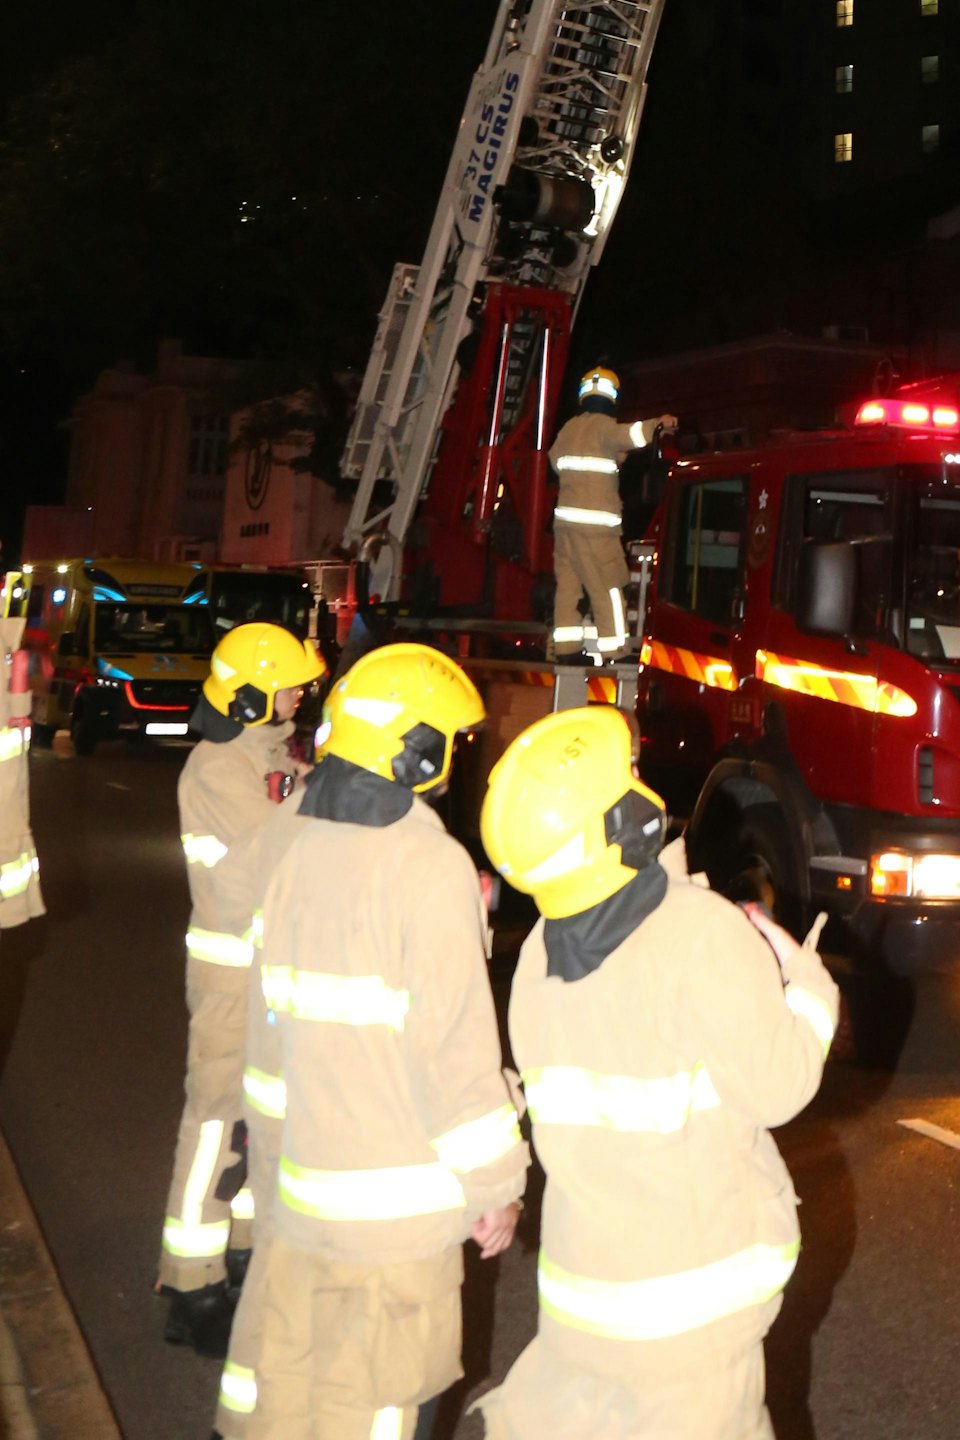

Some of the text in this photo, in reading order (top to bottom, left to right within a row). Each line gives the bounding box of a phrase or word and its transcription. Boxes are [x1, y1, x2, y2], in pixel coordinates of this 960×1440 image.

[464, 103, 494, 181] 37 CS
[468, 72, 520, 223] MAGIRUS
